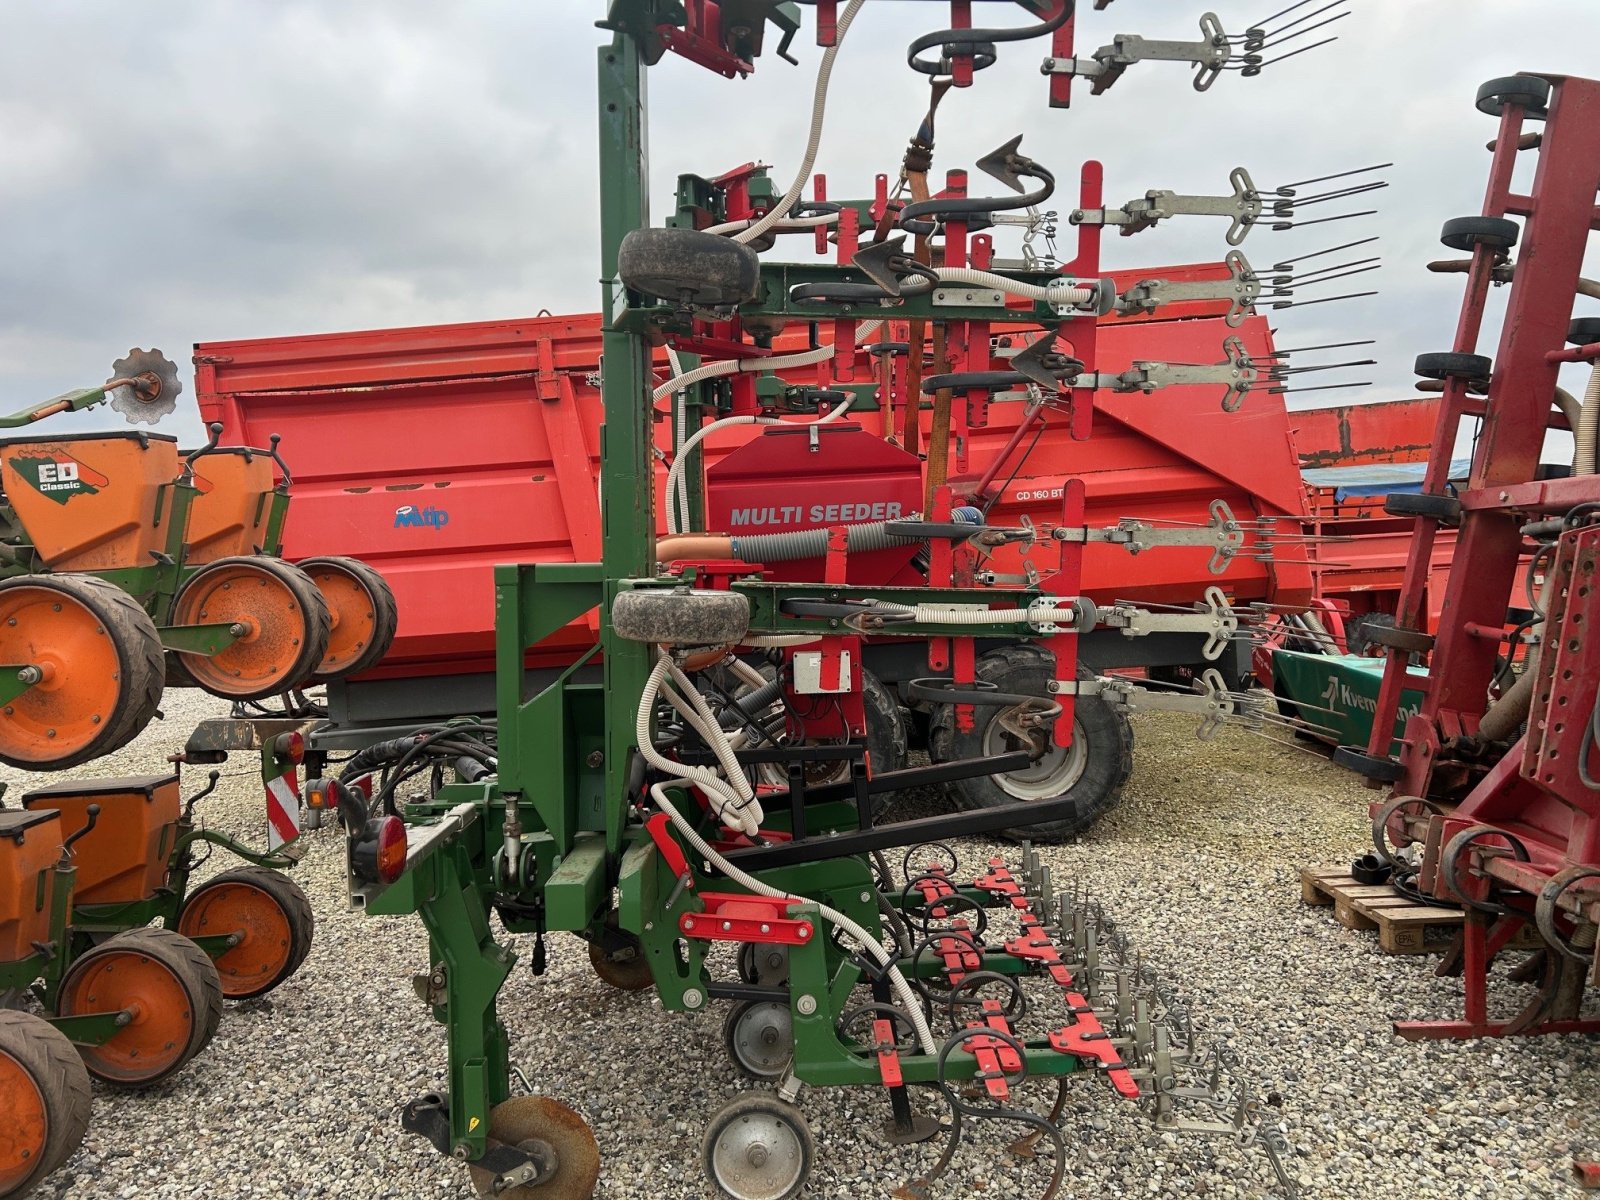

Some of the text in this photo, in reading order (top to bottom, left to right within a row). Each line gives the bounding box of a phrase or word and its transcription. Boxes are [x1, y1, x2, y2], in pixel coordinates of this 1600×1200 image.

[38, 462, 79, 483] ED
[40, 481, 80, 492] Classic
[1016, 488, 1064, 500] CD 160 BT
[731, 501, 902, 526] MULTI SEEDER
